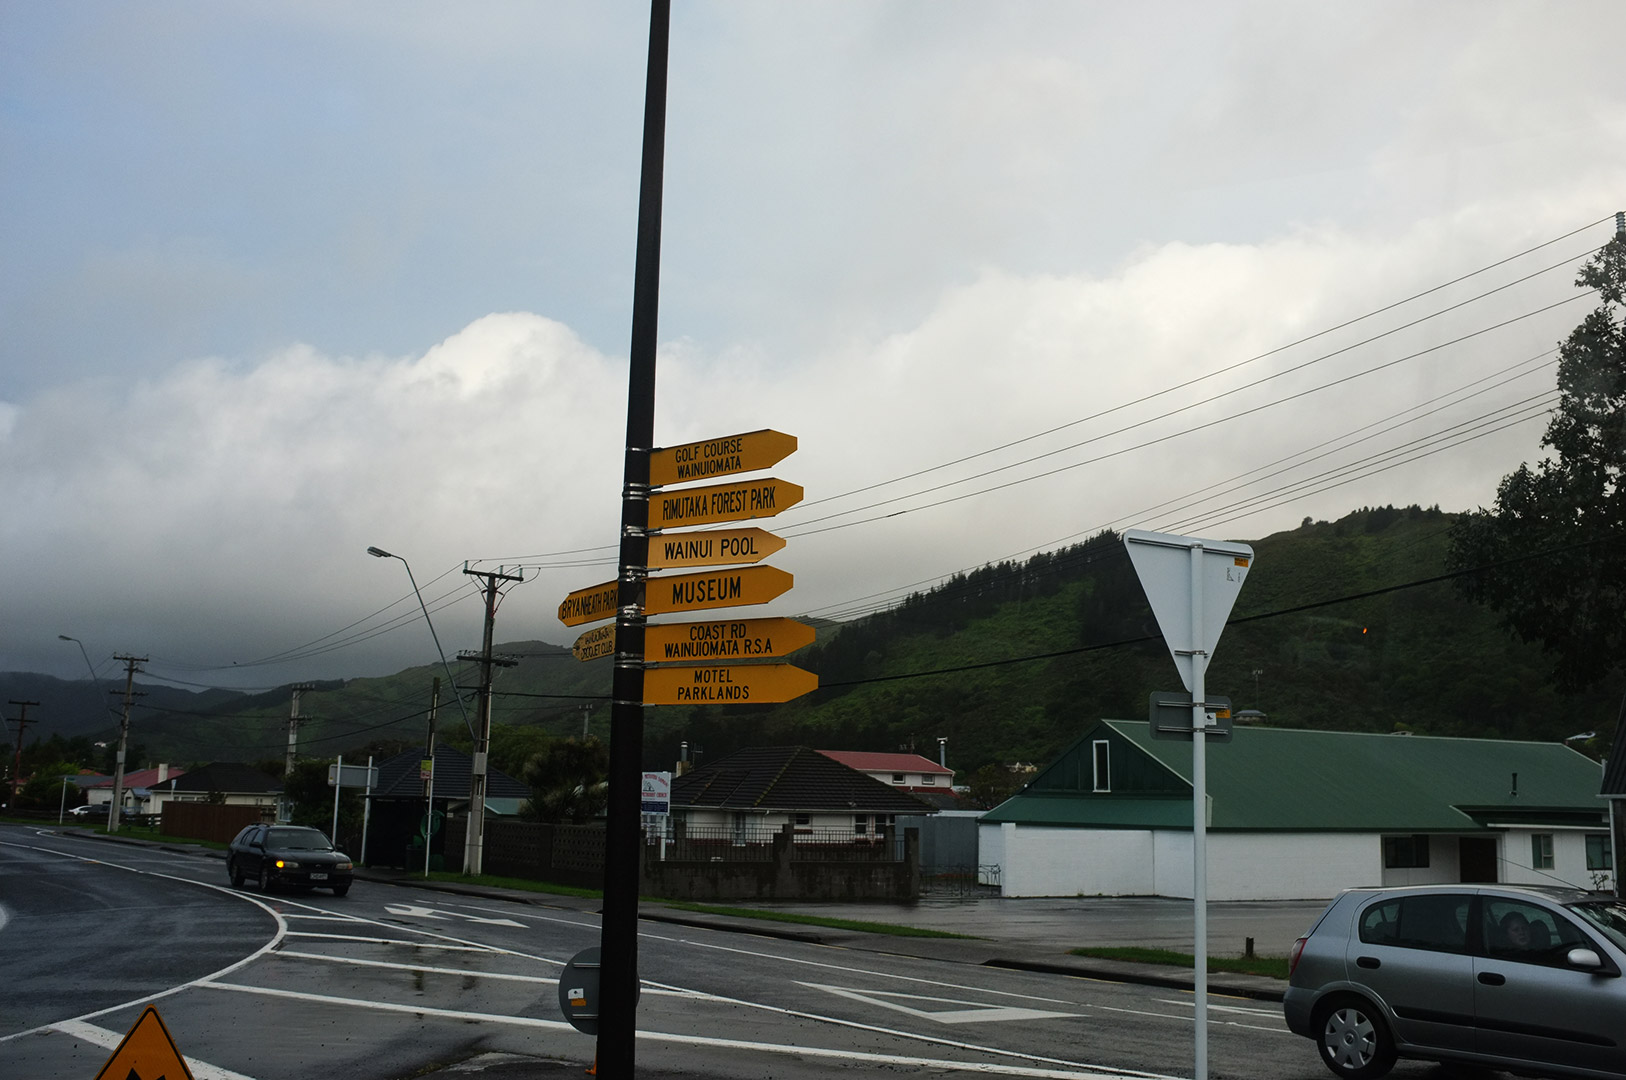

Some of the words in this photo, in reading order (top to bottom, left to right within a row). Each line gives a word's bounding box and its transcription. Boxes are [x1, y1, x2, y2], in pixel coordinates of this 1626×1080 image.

[675, 446, 700, 463] GOLF
[704, 438, 743, 458] COURSE
[677, 455, 742, 479] WAINUIOMATA
[663, 495, 708, 520] RIMUTAKA
[711, 490, 748, 514] FOREST
[750, 486, 776, 510] PARK
[664, 539, 713, 560] WAINUI
[720, 537, 758, 557] POOL
[672, 576, 741, 604] MUSEUM
[689, 624, 726, 641] COAST
[730, 623, 746, 639] RD
[664, 640, 739, 658] WAINUIOMATA
[694, 669, 733, 683] MOTEL
[677, 686, 750, 700] PARKLANDS
